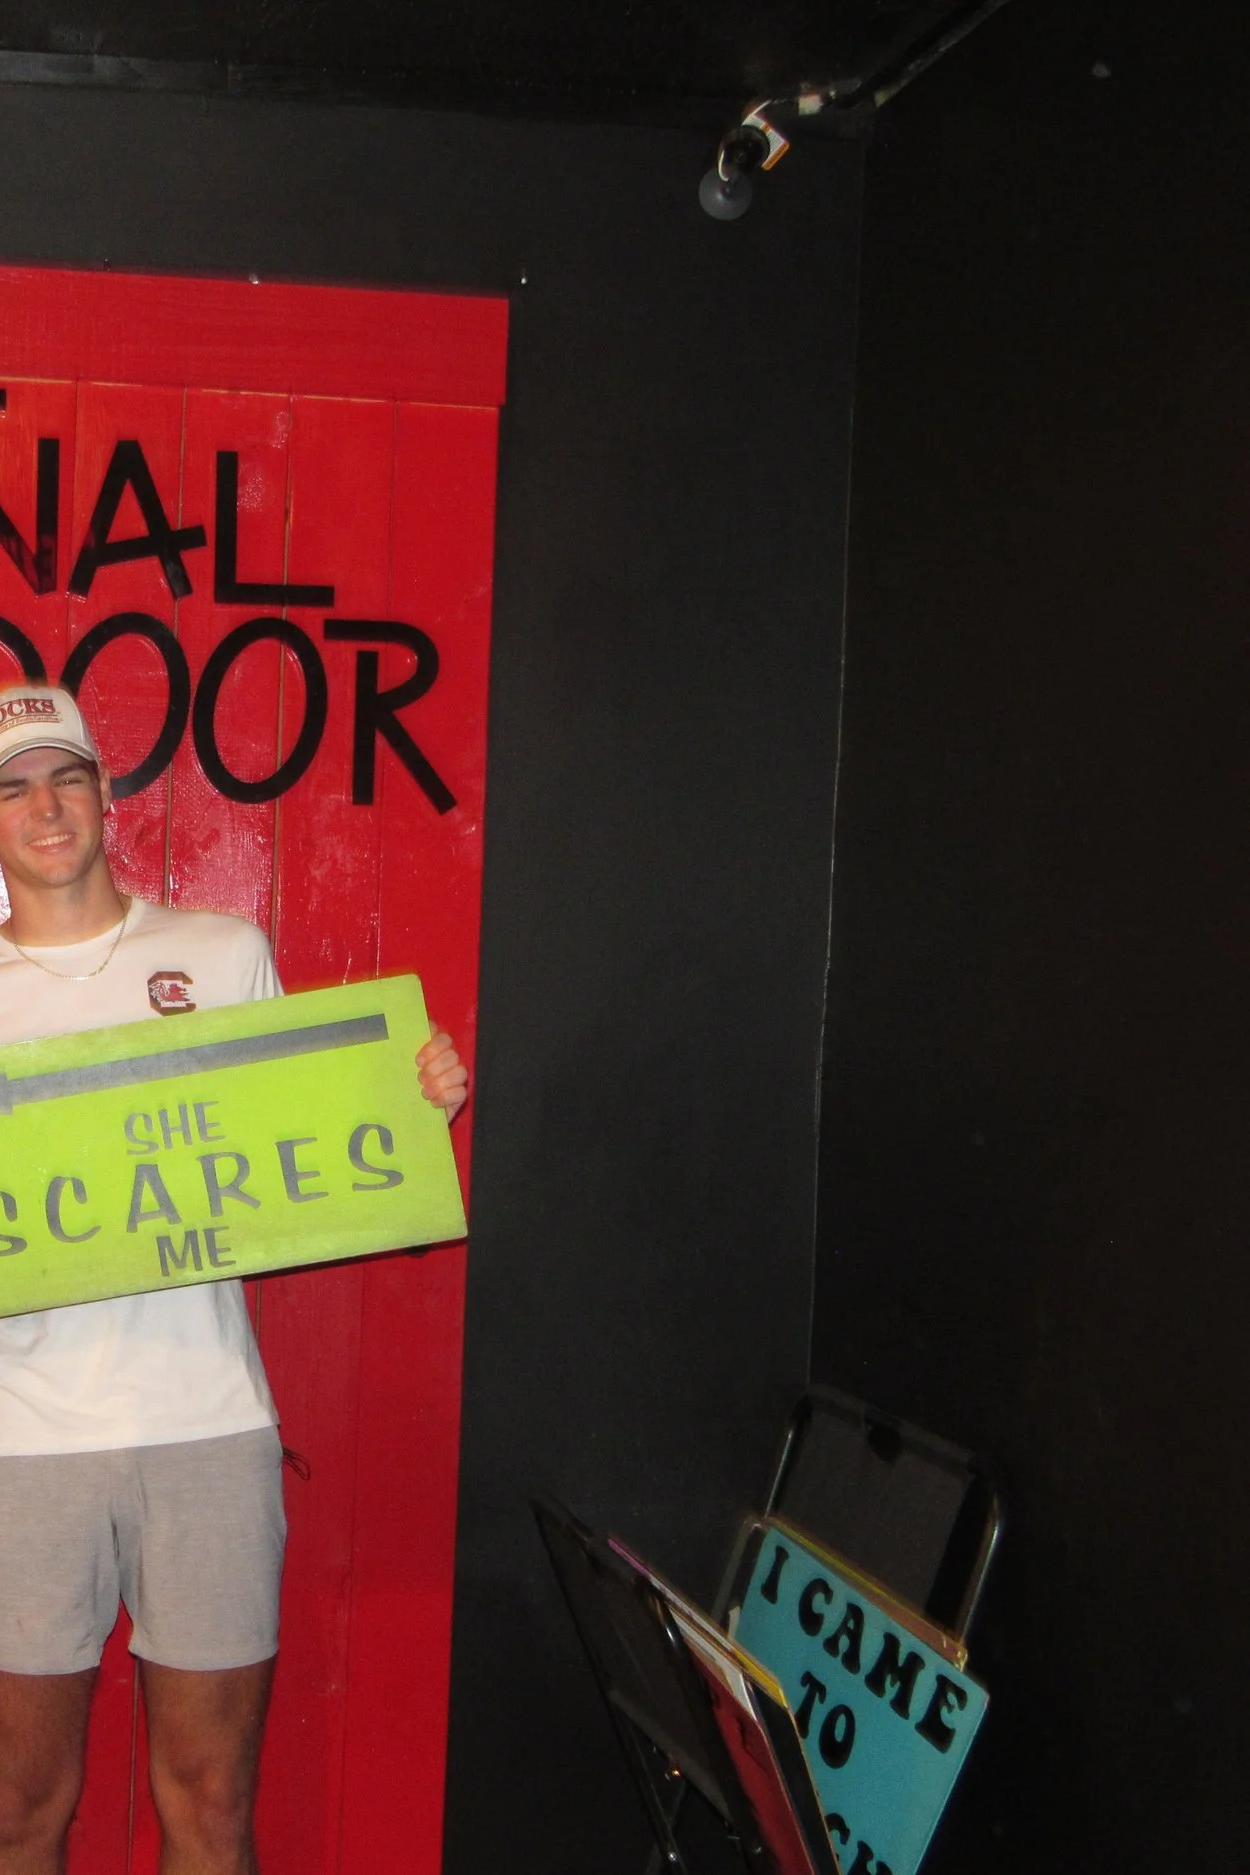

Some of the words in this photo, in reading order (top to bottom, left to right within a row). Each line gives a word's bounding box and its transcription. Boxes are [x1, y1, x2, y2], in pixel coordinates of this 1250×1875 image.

[123, 1100, 226, 1156] SHE
[155, 1226, 237, 1277] ME
[760, 1545, 790, 1605] I
[798, 1577, 968, 1754] CAME
[798, 1670, 857, 1770] TO
